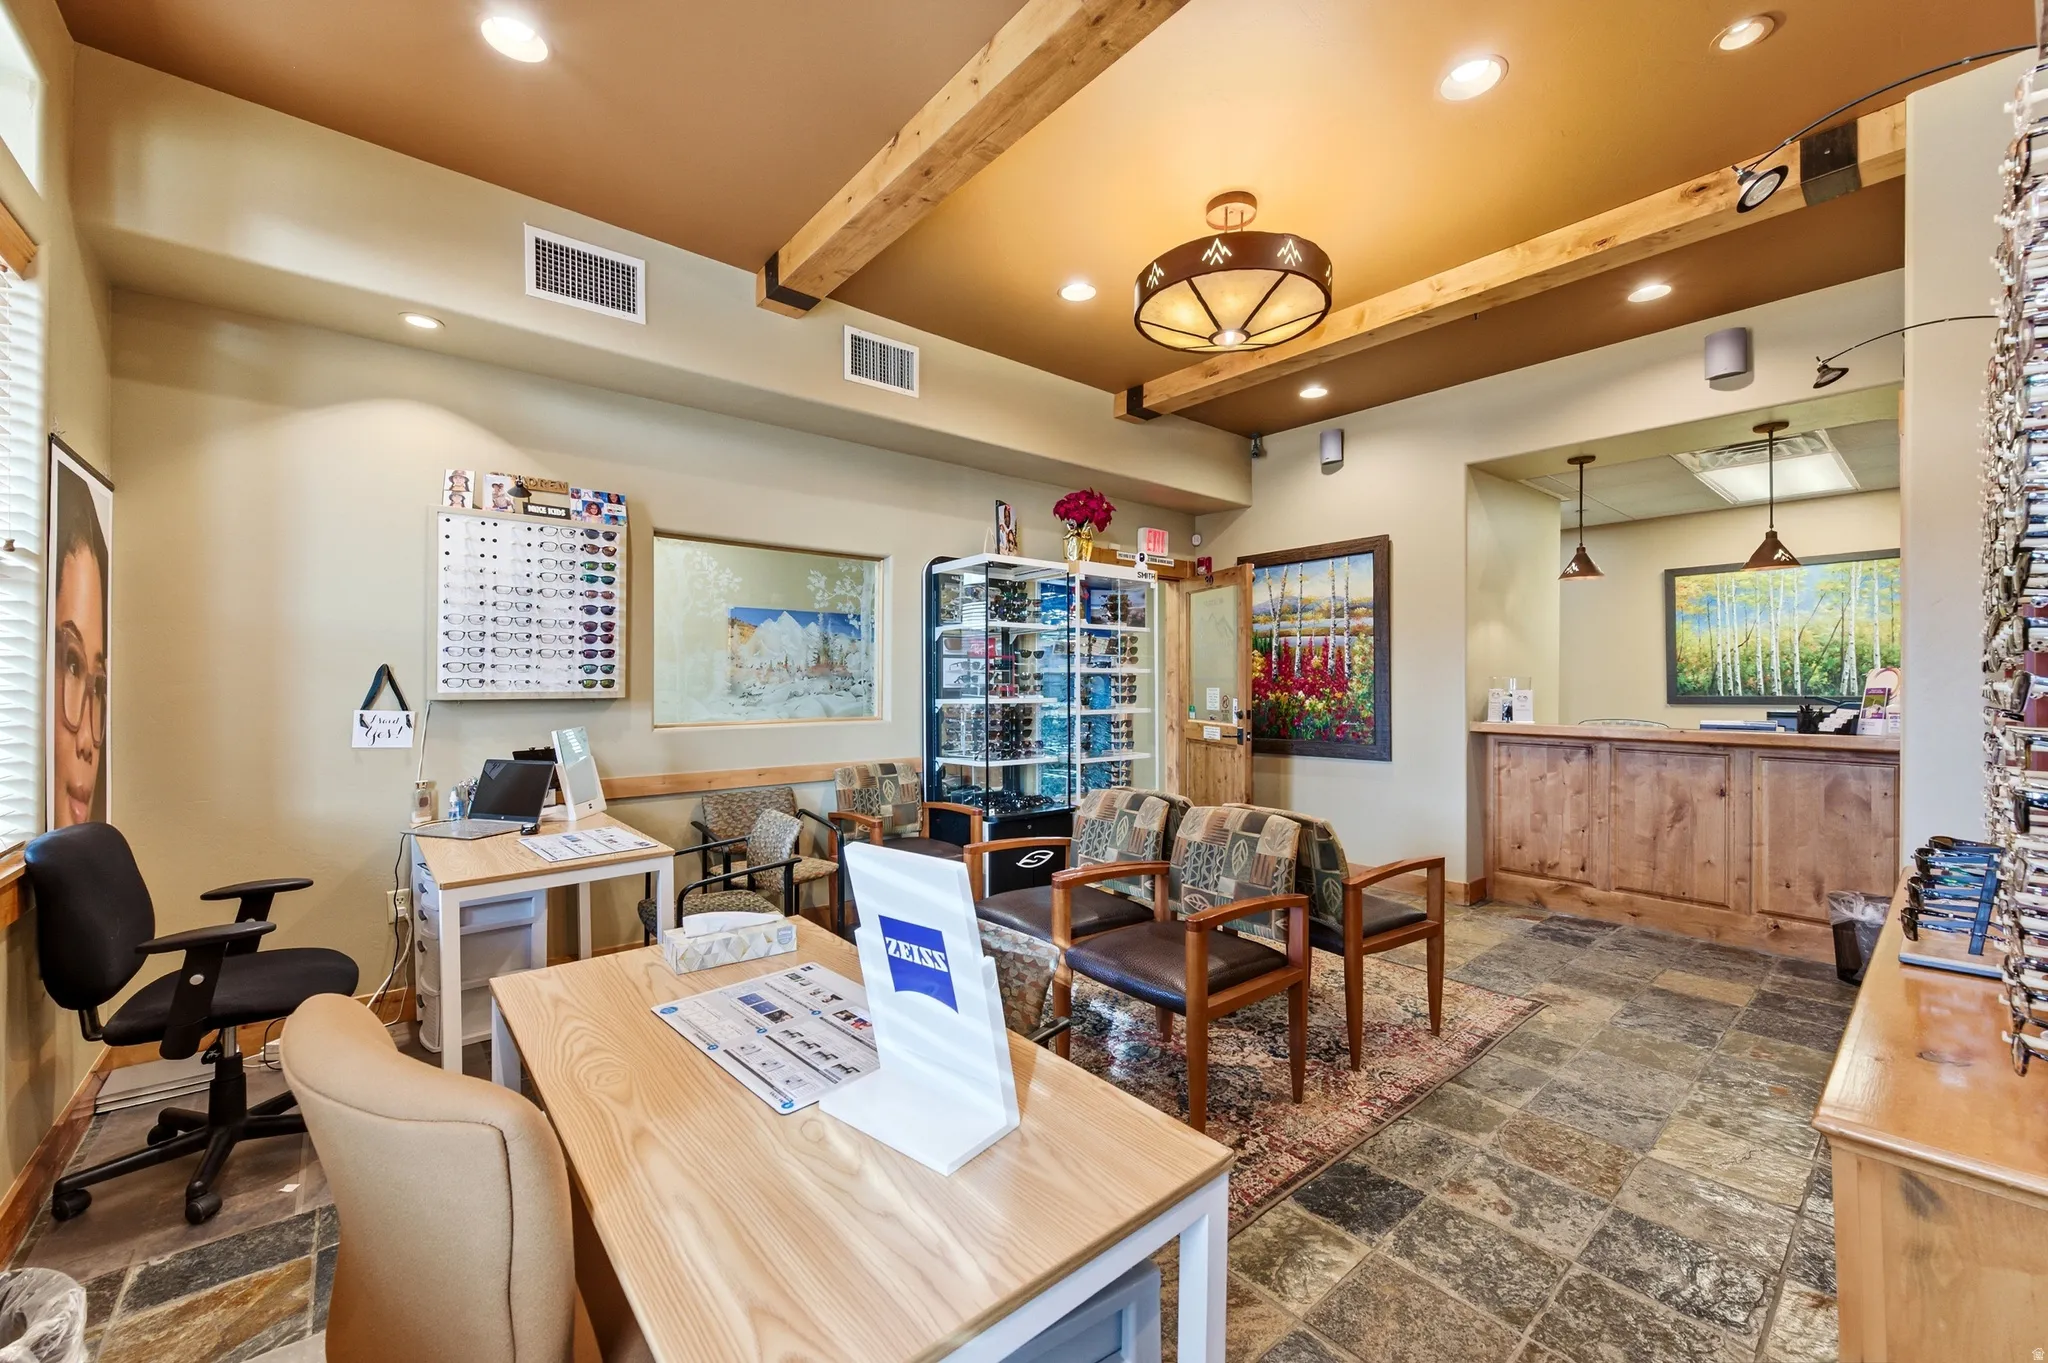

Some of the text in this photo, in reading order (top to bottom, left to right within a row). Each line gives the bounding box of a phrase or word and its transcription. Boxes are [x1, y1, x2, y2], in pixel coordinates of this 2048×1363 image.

[527, 504, 566, 517] NIKE KIDS
[1147, 529, 1166, 553] EXIT
[1137, 571, 1156, 580] SMITH
[884, 936, 949, 973] ZEISS
